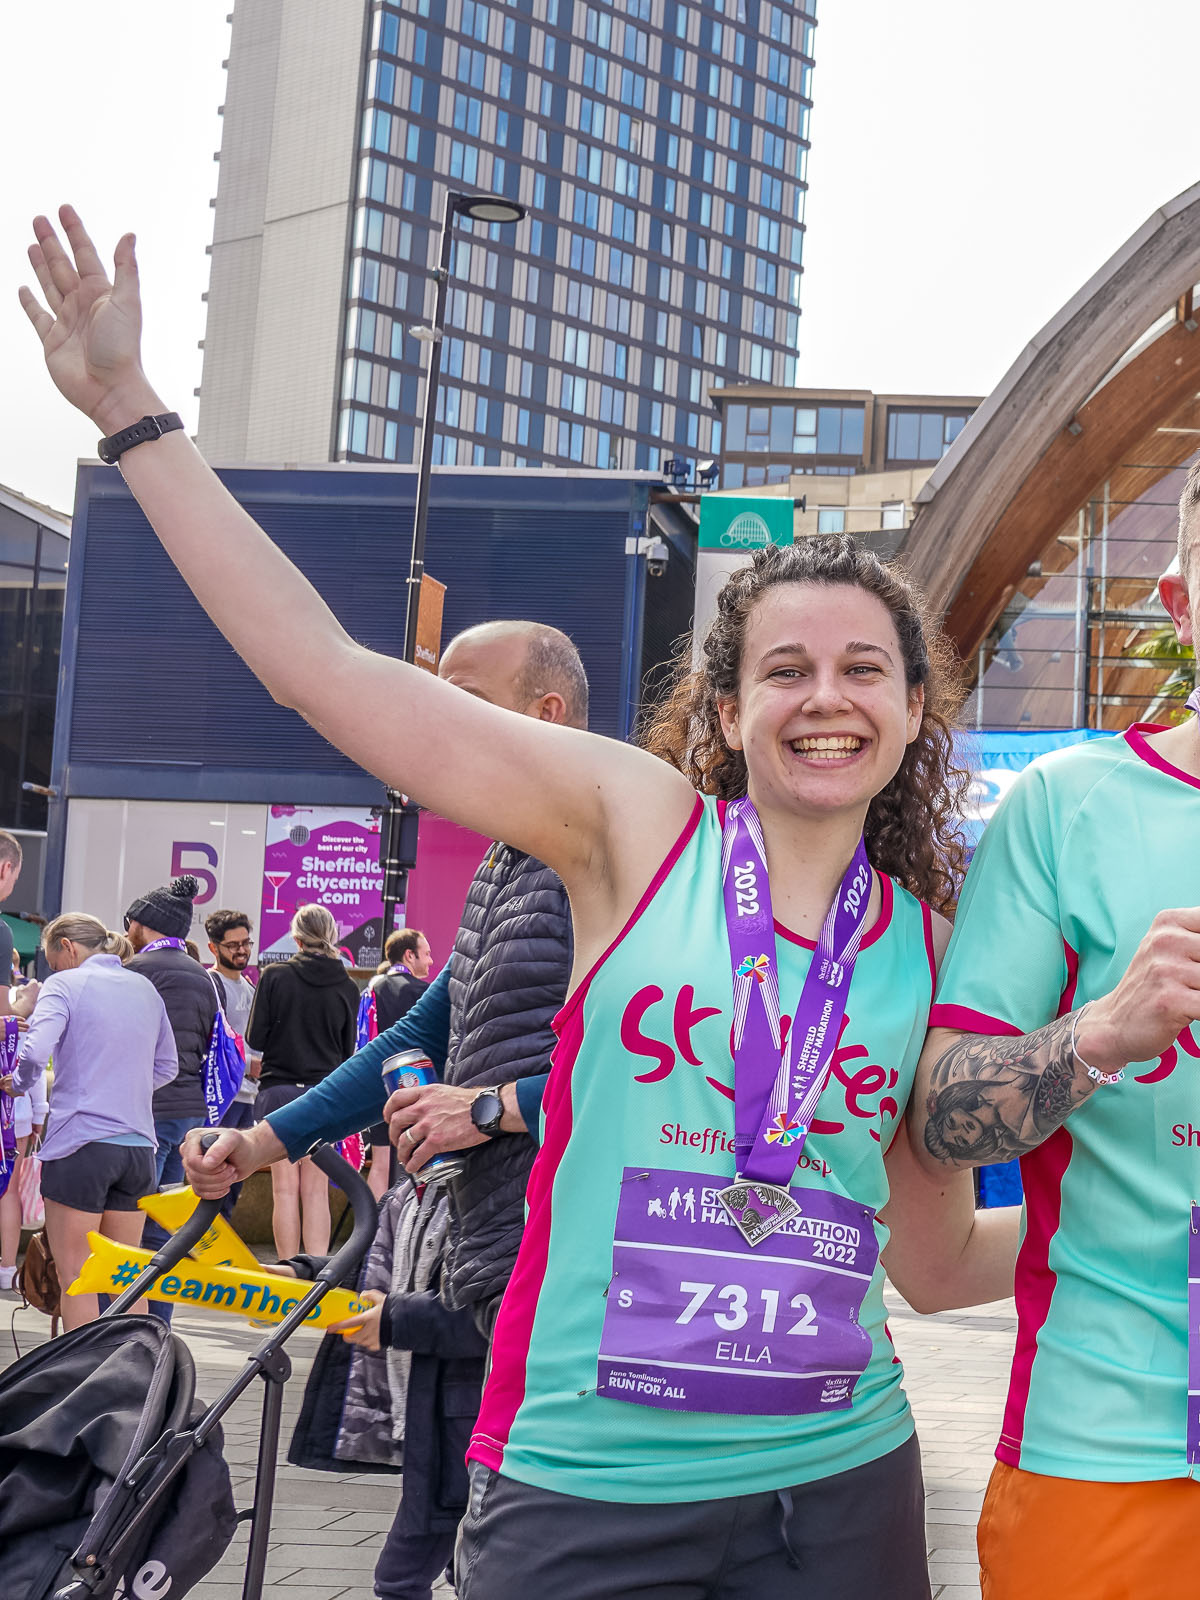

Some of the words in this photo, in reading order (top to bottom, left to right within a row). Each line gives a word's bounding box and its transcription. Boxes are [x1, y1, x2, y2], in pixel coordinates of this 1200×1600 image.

[317, 844, 333, 852] best
[333, 844, 341, 852] of
[354, 845, 368, 854] city
[322, 835, 352, 843] Discover
[352, 835, 364, 844] the
[301, 856, 382, 873] Sheffield
[296, 873, 384, 892] citycentre
[734, 861, 760, 917] 2022
[843, 864, 869, 919] 2022
[317, 892, 360, 905] .com
[153, 939, 171, 949] 2022
[7, 1033, 17, 1053] 2022
[620, 984, 723, 1084] St
[806, 1047, 821, 1074] HALF
[818, 999, 834, 1050] MARATHON
[797, 1025, 817, 1071] SHEFFIELD
[206, 1079, 217, 1104] FOR
[207, 1105, 221, 1125] ALL
[659, 1123, 736, 1154] Sheffie
[701, 1210, 736, 1227] HAL
[812, 1239, 857, 1265] 2022
[617, 1289, 633, 1308] S
[675, 1281, 818, 1336] 7312
[715, 1341, 772, 1364] ELLA
[608, 1376, 636, 1391] RUN
[636, 1381, 661, 1396] FOR
[662, 1386, 687, 1399] ALL
[609, 1369, 627, 1377] Jane
[628, 1372, 667, 1385] Tomlinson's
